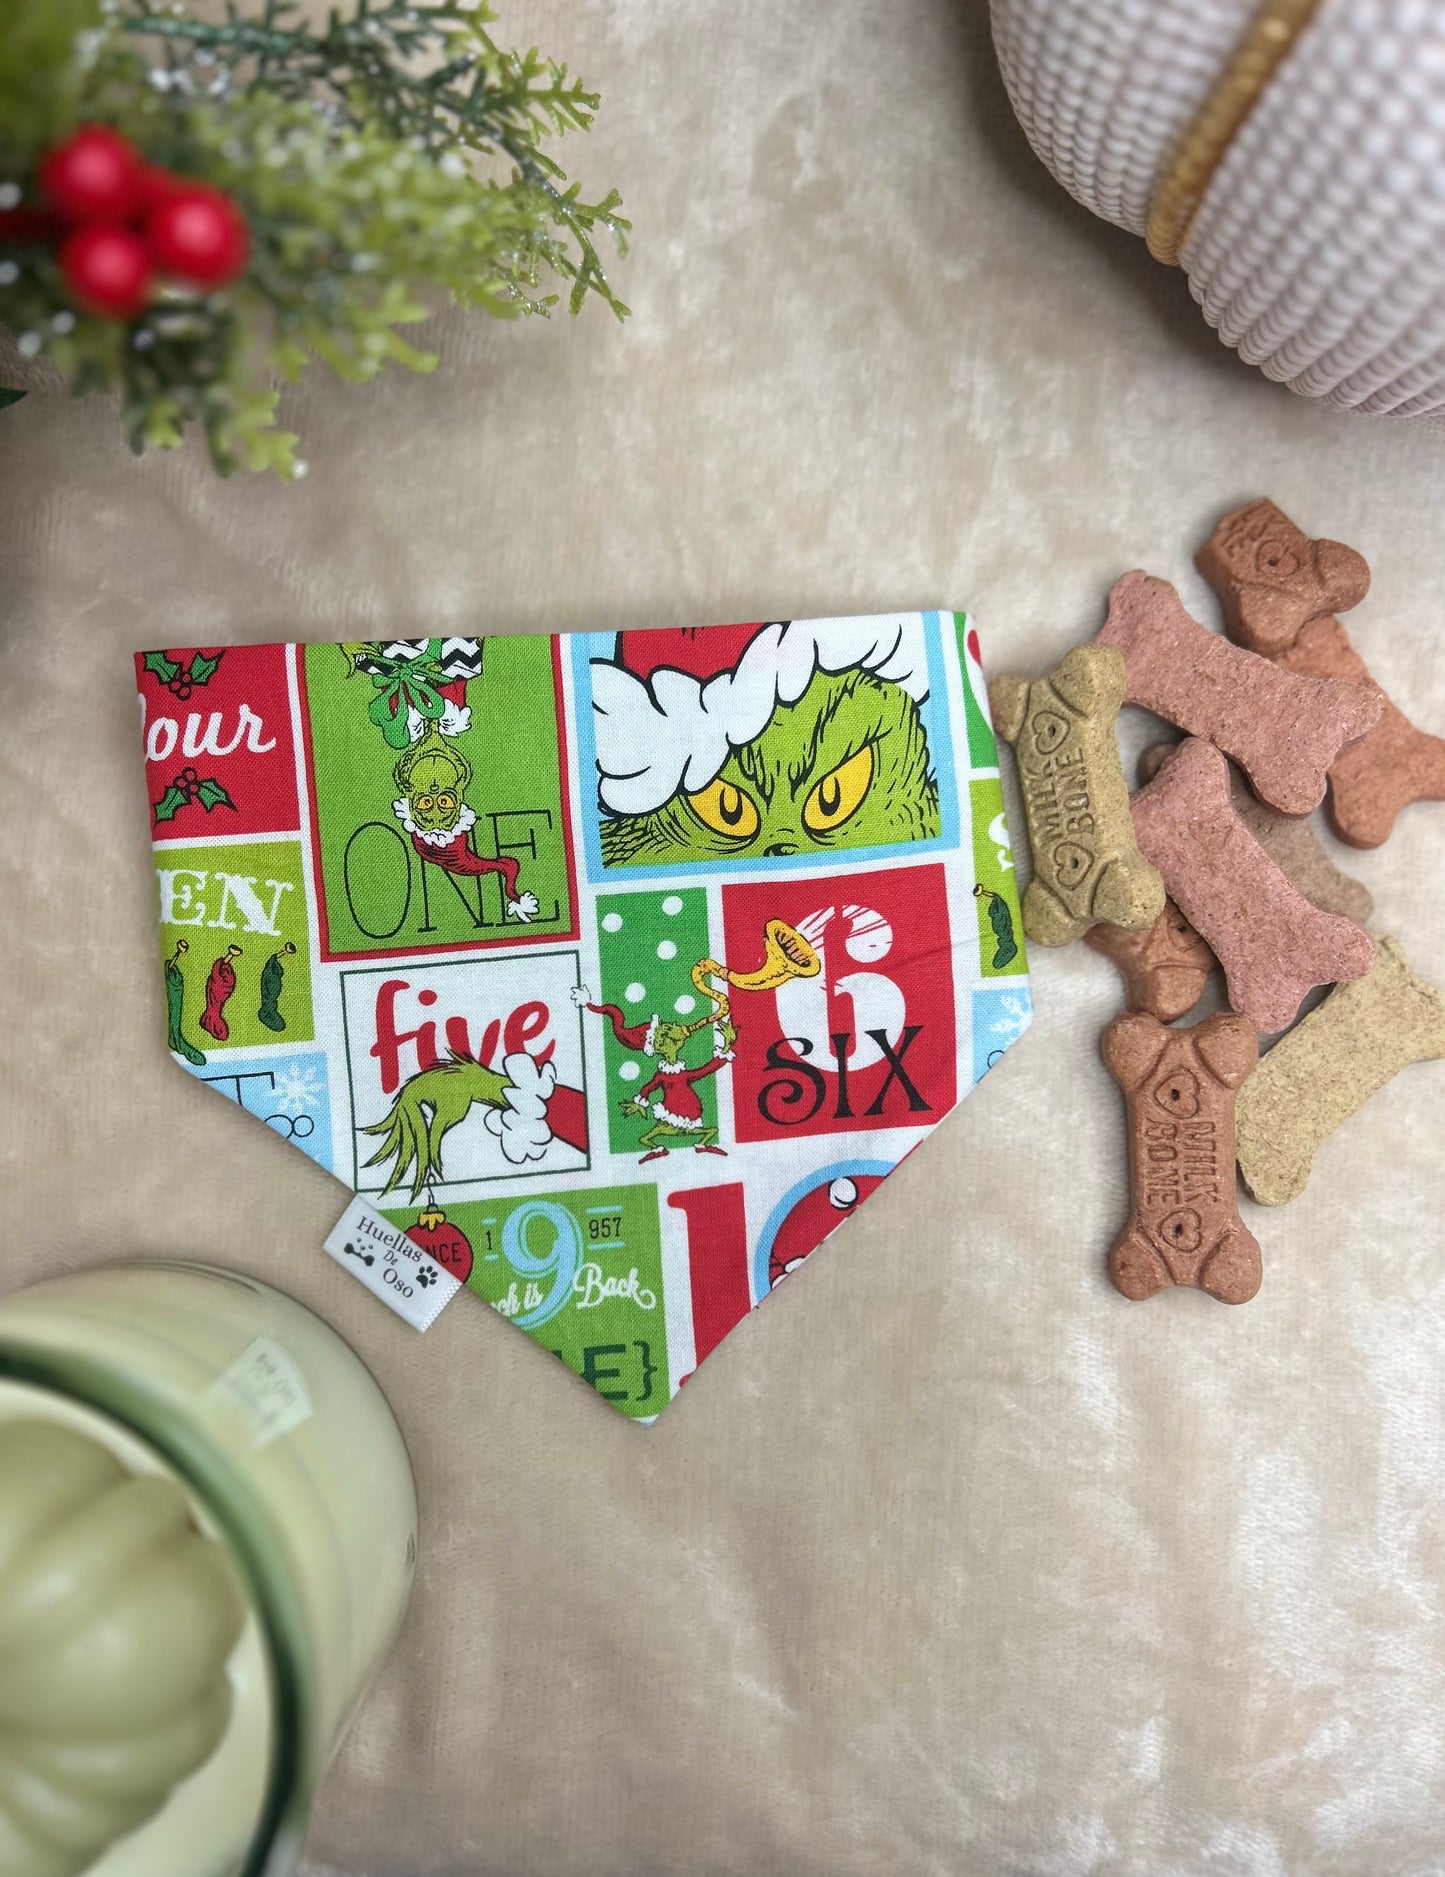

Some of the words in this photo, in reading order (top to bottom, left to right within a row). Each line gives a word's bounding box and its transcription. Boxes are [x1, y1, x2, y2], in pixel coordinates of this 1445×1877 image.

[139, 692, 277, 763] our
[1057, 748, 1096, 836] BONE
[344, 809, 560, 940] ONE
[775, 904, 908, 1073] 6
[369, 979, 556, 1095] five
[757, 1025, 933, 1126] SIX
[1146, 1116, 1181, 1205] BONE
[1182, 1120, 1219, 1204] MILK
[356, 1215, 423, 1262] Huellas
[383, 1249, 398, 1266] De
[501, 1199, 585, 1330] 9
[589, 1217, 621, 1239] 957
[383, 1268, 414, 1298] Oso
[573, 1262, 657, 1310] Back
